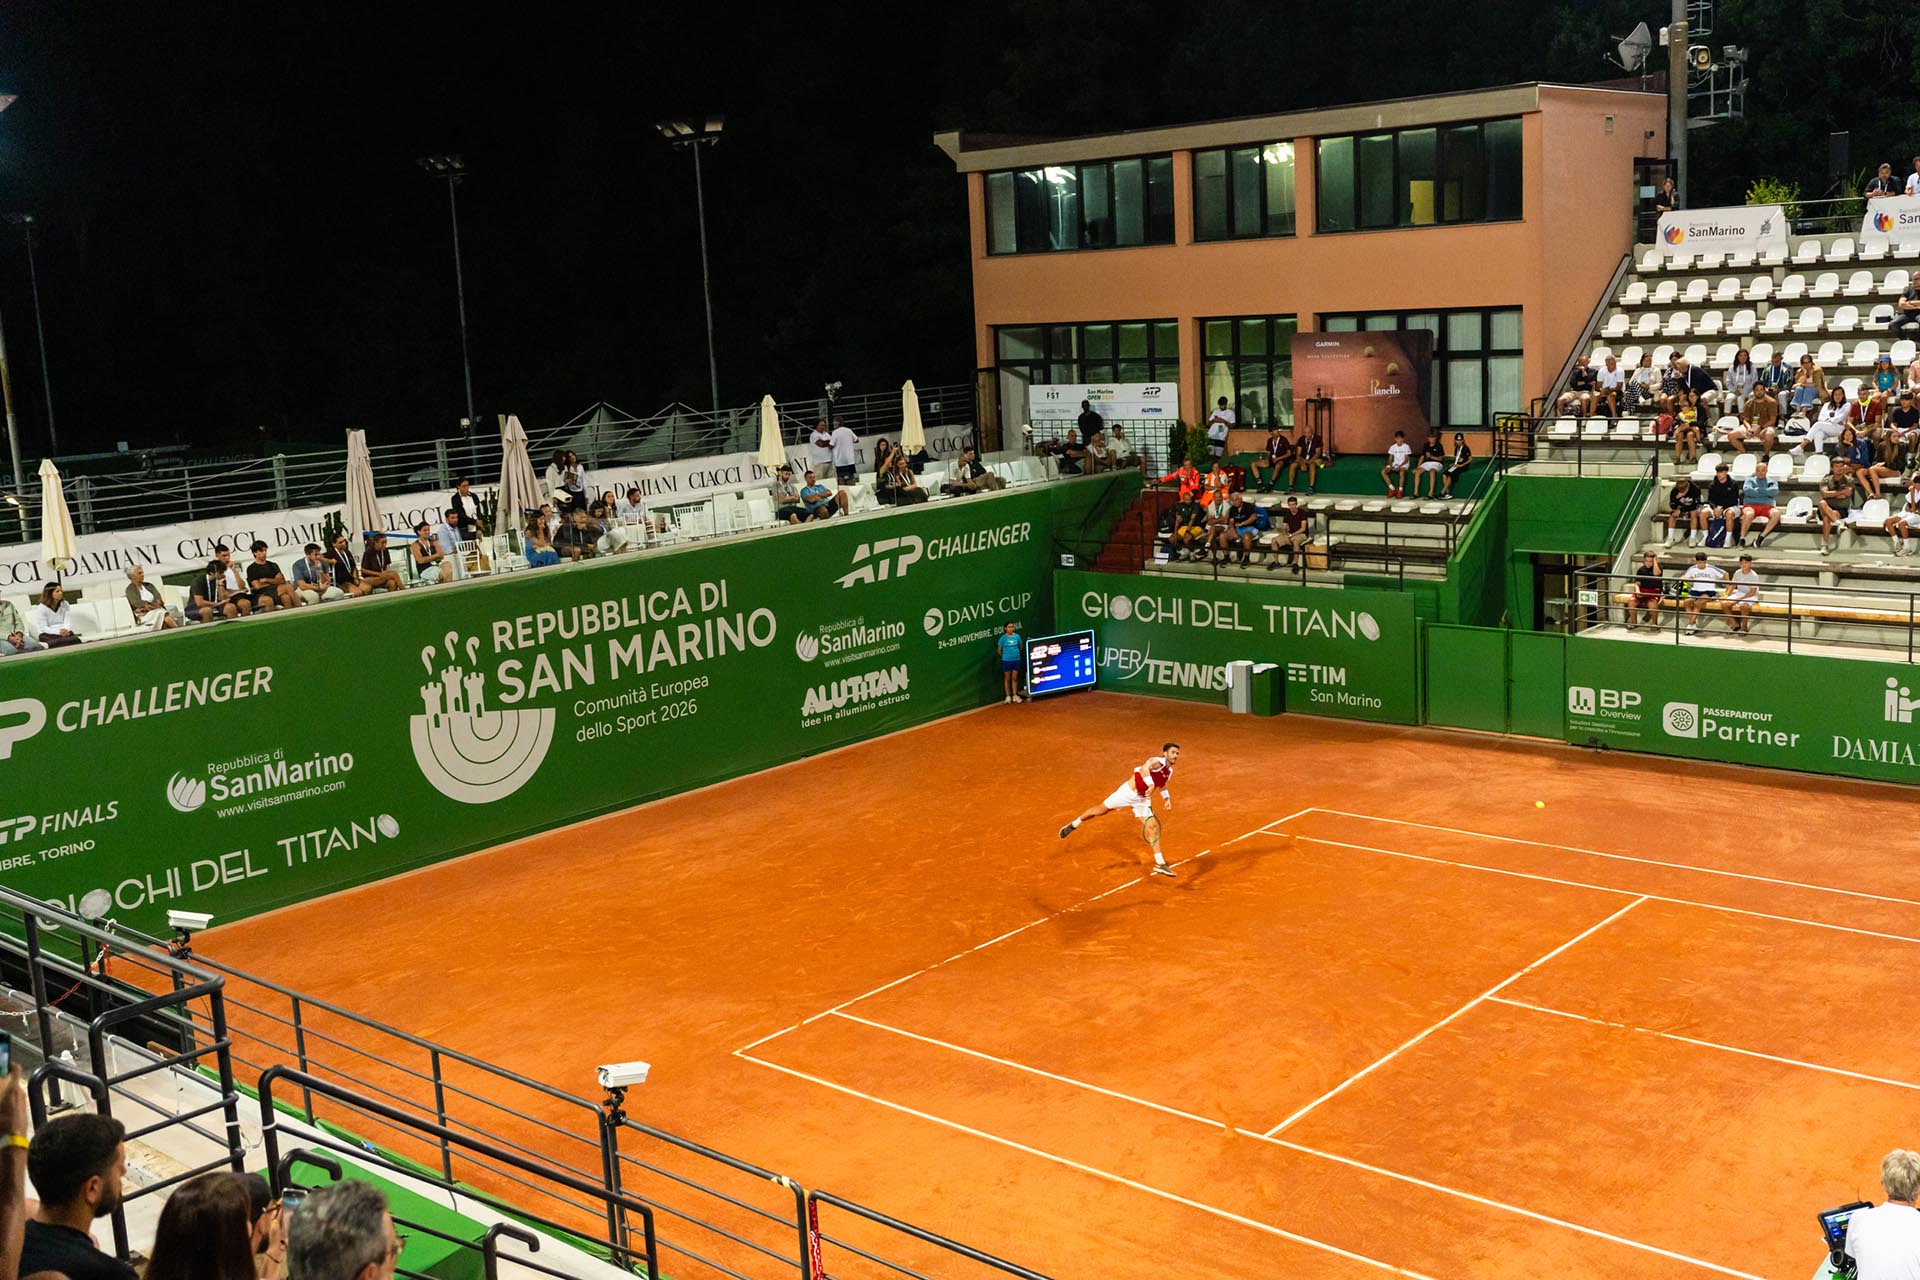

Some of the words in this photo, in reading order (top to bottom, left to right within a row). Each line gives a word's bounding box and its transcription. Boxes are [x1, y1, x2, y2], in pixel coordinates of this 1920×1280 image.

[1688, 225, 1745, 237] SanMarino
[1143, 386, 1161, 395] ATP
[64, 544, 163, 577] DAMIANI
[177, 531, 257, 560] CIACCI
[688, 466, 742, 489] CIACCI
[833, 535, 924, 589] ATP
[927, 522, 1030, 561] CHALLENGER
[492, 587, 692, 654] REPUBBLICA
[700, 579, 728, 612] DI
[819, 619, 856, 634] Repubblica
[857, 616, 865, 625] di
[947, 600, 994, 626] DAVIS
[998, 592, 1031, 613] CUP
[1081, 591, 1183, 626] GIOCHI
[1191, 599, 1253, 631] DEL
[1262, 604, 1381, 641] TITANO
[820, 620, 905, 655] SanMarino
[497, 643, 595, 704] SAN
[608, 607, 777, 681] MARINO
[823, 643, 900, 668] www.visitsanmarino.com
[1096, 646, 1141, 670] UPER
[1145, 659, 1228, 691] TENNIS
[801, 664, 909, 717] ALUTITAN
[1309, 664, 1346, 686] TIM
[56, 665, 274, 733] CHALLENGER
[573, 687, 647, 717] Comunità
[650, 675, 709, 700] Europea
[801, 718, 821, 728] Idee
[823, 713, 833, 722] in
[835, 702, 876, 719] alluminio
[879, 693, 910, 707] estruso
[1310, 688, 1334, 704] San
[1337, 691, 1382, 709] Marino
[1600, 689, 1641, 709] BP
[576, 721, 612, 742] dello
[616, 710, 657, 734] Sport
[660, 699, 698, 722] 2026
[1600, 709, 1641, 720] Overview
[1703, 707, 1773, 722] PASSEPARTOUT
[1702, 718, 1800, 748] Partner
[207, 753, 270, 775] Repubblica
[273, 748, 284, 760] di
[1832, 735, 1920, 767] DAMIA
[210, 752, 354, 801] SanMarino
[216, 780, 346, 818] www.visitsanmarino.com
[41, 800, 118, 835] FINALS
[38, 840, 95, 861] TORINO
[191, 850, 268, 891] DEL
[277, 813, 400, 867] TITANO
